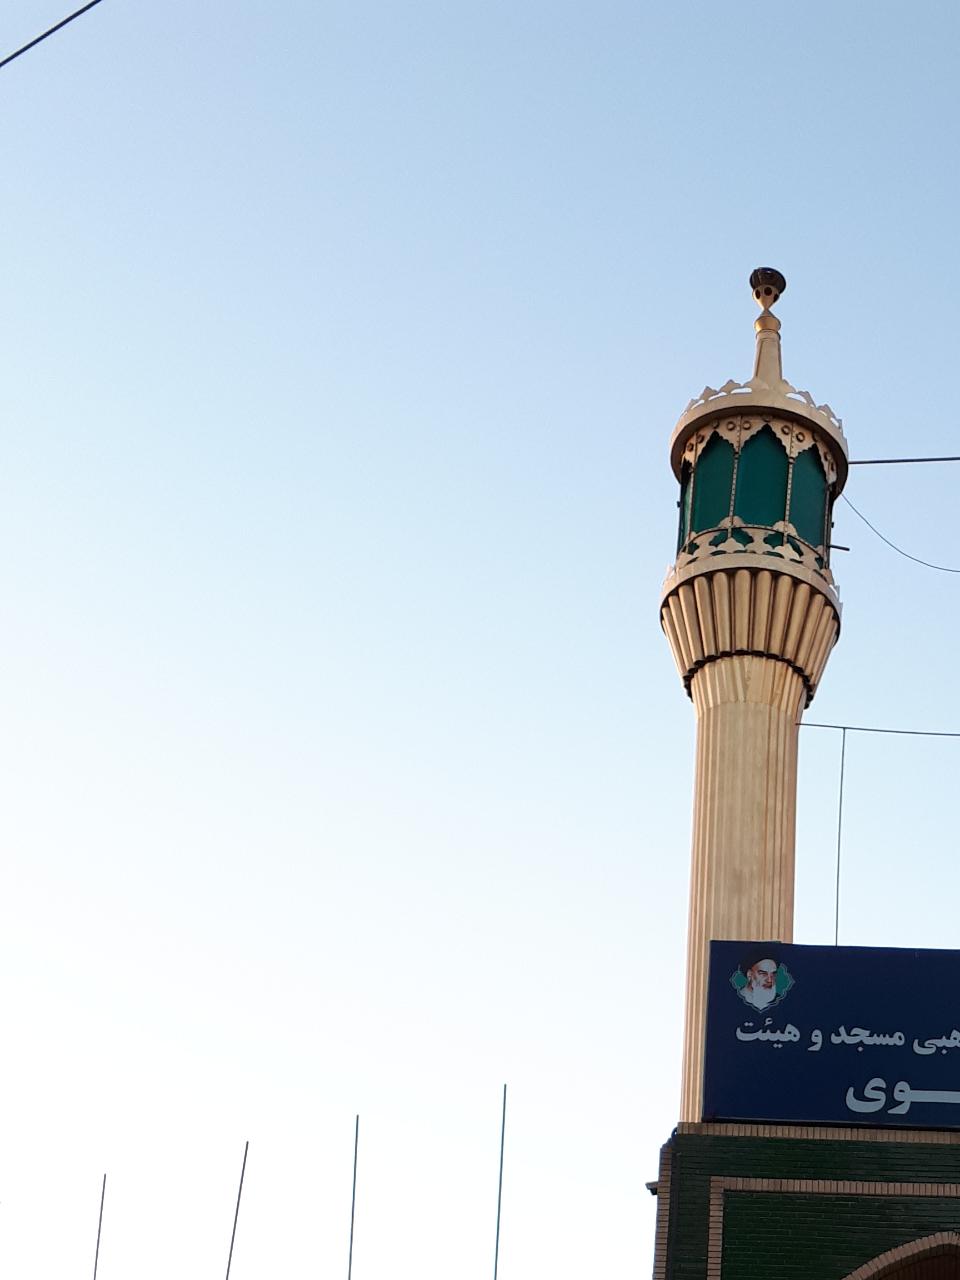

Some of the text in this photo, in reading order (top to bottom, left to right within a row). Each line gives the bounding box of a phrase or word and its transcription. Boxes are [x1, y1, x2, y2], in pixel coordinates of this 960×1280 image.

[735, 1017, 800, 1049] هیئت
[807, 1027, 823, 1051] و
[830, 1023, 905, 1052] مسجد
